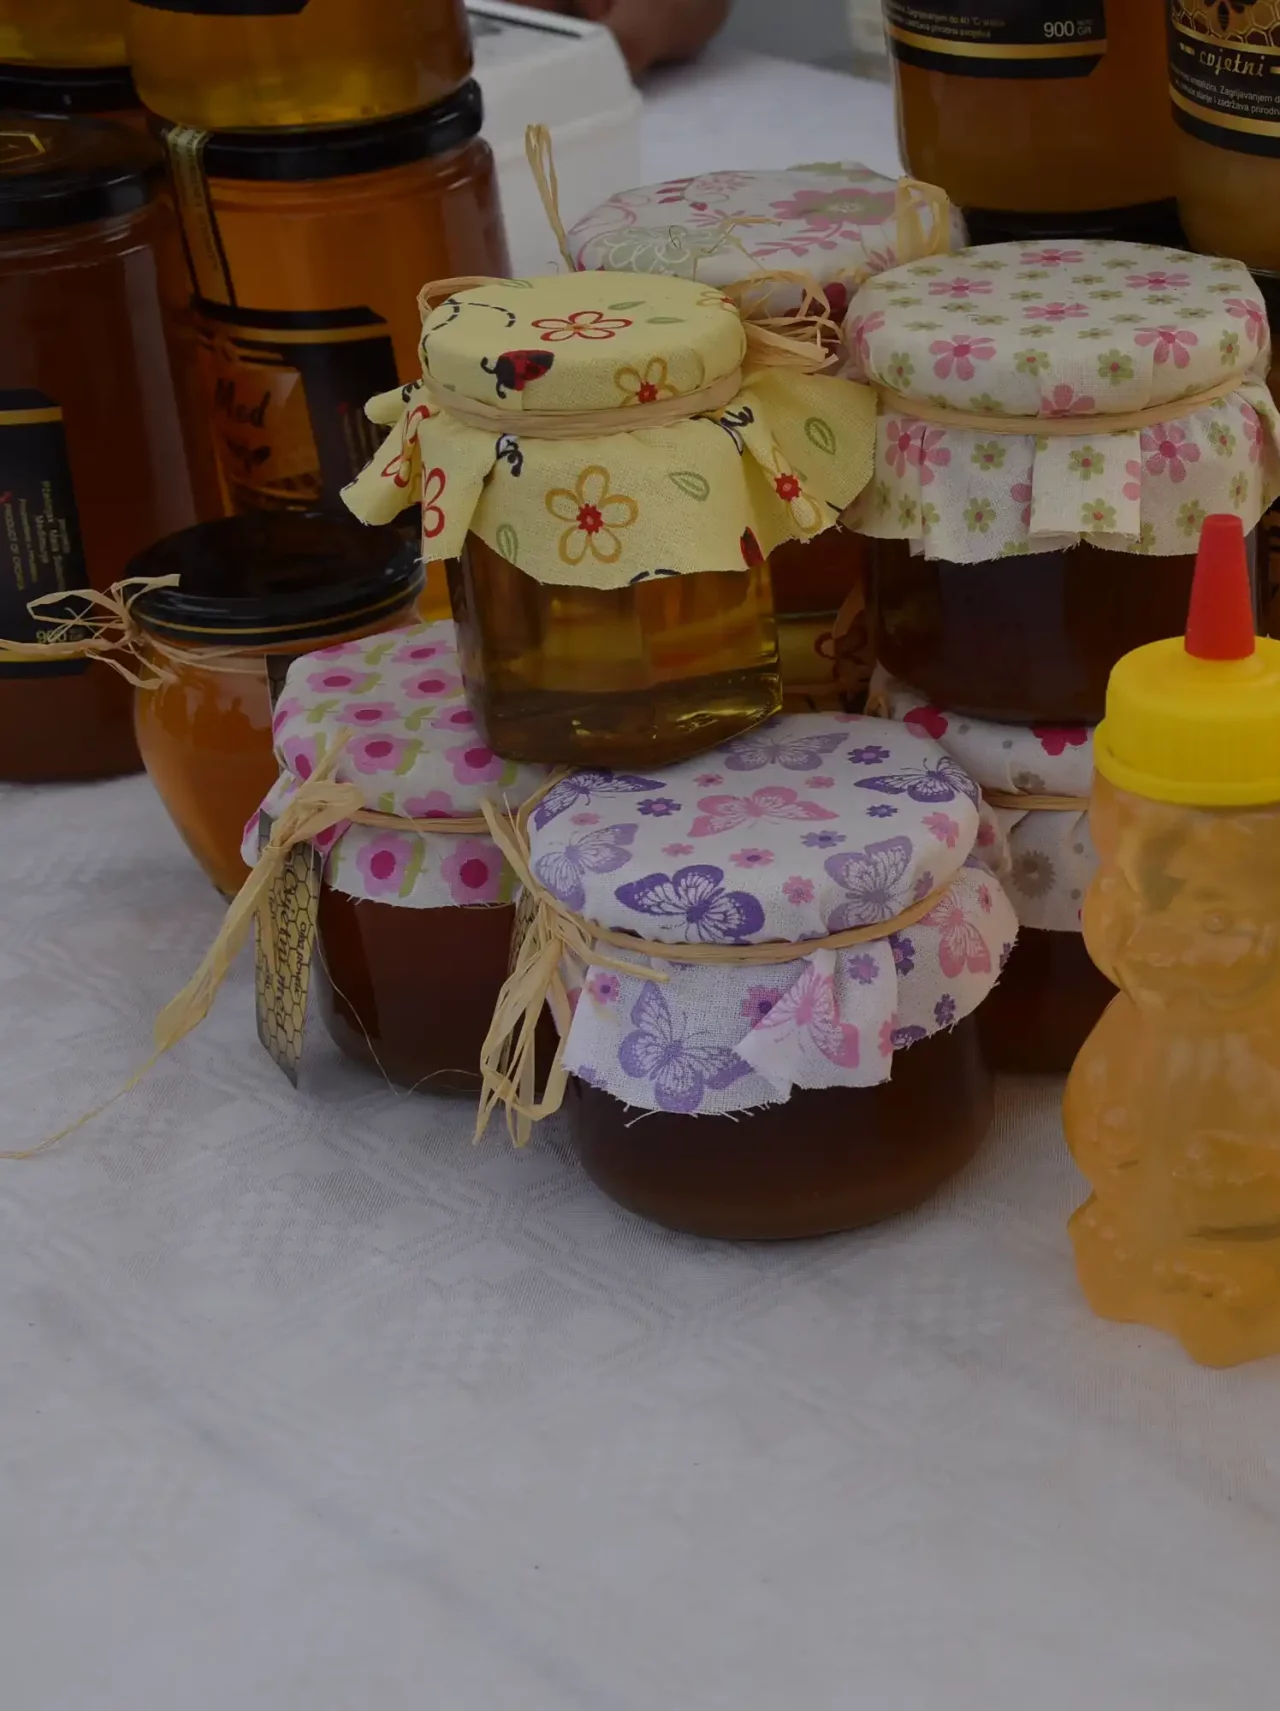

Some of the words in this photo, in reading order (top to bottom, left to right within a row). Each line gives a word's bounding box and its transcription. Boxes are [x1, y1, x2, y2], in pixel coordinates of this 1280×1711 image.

[1043, 20, 1075, 38] 900
[1199, 48, 1265, 77] cvjetni
[1219, 85, 1273, 104] Zagrijavanjem
